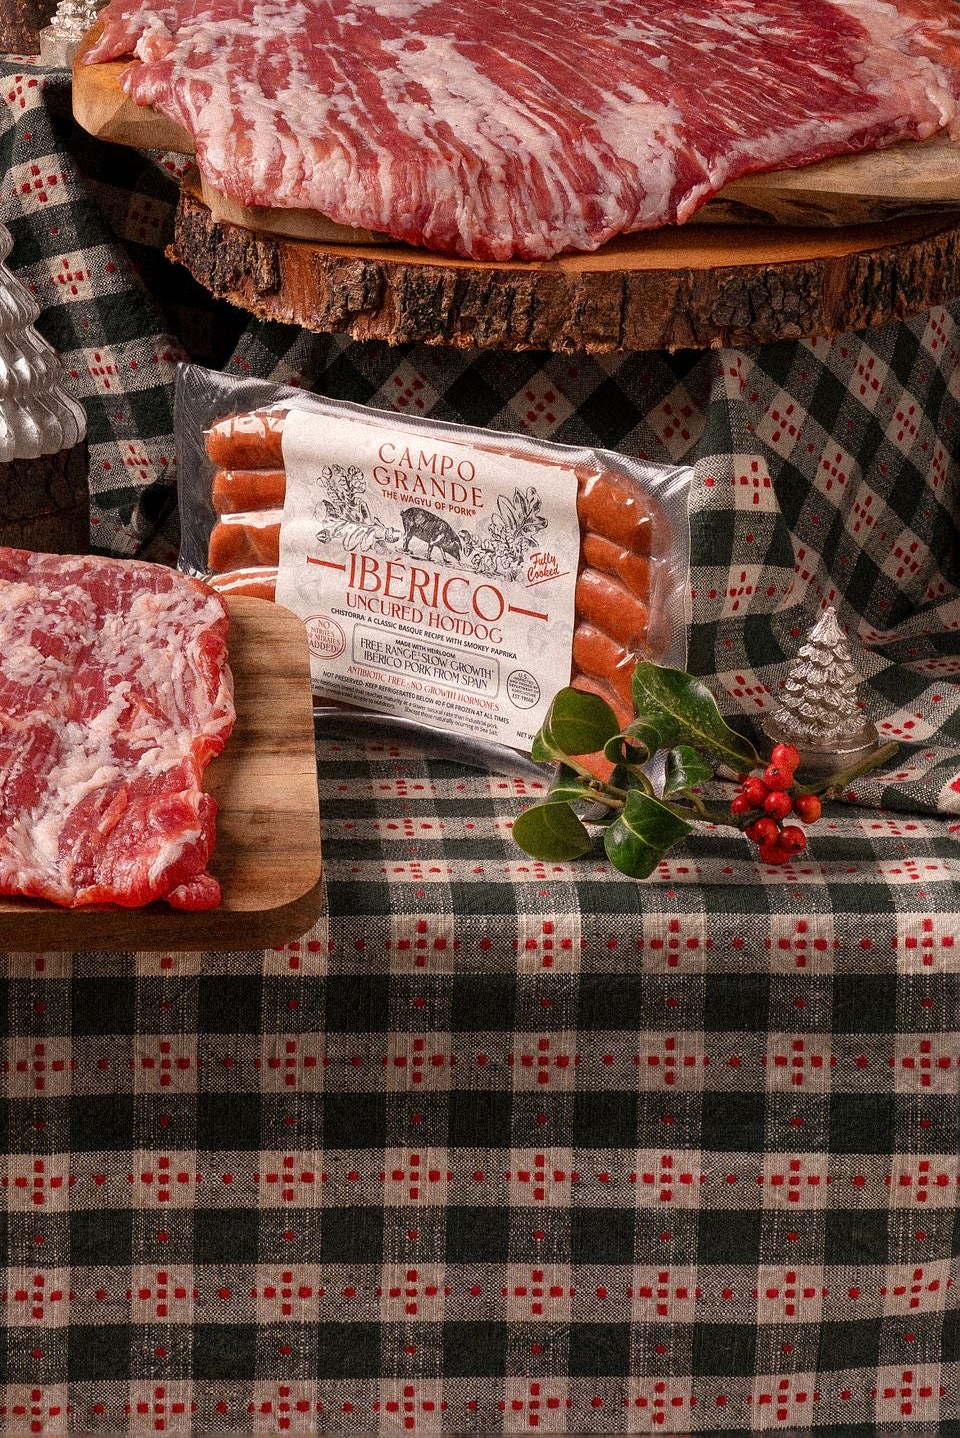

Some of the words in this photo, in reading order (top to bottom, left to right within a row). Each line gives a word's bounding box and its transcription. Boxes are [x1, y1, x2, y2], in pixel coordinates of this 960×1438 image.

[378, 442, 476, 481] CAMPO
[373, 466, 484, 508] GRANDE
[382, 489, 397, 500] THE
[400, 493, 432, 508] WAGYU
[434, 501, 446, 511] OF
[527, 563, 560, 582] Cooked
[529, 552, 557, 570] Fully
[348, 552, 505, 622] IBÉRICO
[318, 619, 330, 629] NO
[346, 592, 423, 624] UNCURED
[428, 612, 503, 644] HOTDOG
[360, 637, 383, 652] FREE
[421, 652, 447, 668] SLOW
[373, 617, 398, 630] CLASSIC
[398, 624, 423, 636] BASQUE
[424, 630, 444, 641] RECIPE
[445, 635, 462, 646] WITH
[463, 640, 490, 653] SMOKEY
[491, 647, 518, 660] PAPRIKA
[395, 639, 411, 648] MADE
[412, 643, 427, 652] WITH
[427, 647, 456, 659] HEIRLOOM
[347, 665, 387, 681] ANTIBIOTIC
[388, 675, 406, 687] FREE
[411, 681, 423, 691] NO
[424, 684, 456, 700] GROWTH
[457, 692, 500, 711] HORMONES
[404, 662, 431, 676] PORK
[433, 666, 459, 684] FROM
[462, 674, 488, 691] SPAIN
[323, 670, 334, 679] NOT
[365, 681, 378, 690] KEEP
[378, 684, 416, 699] REFRIGERATED
[416, 692, 434, 704] BELOW
[446, 701, 455, 709] OR
[455, 704, 476, 715] FROZEN
[476, 709, 483, 717] AT
[483, 711, 493, 720] ALL
[494, 715, 510, 724] TIMES
[516, 730, 527, 739] NET
